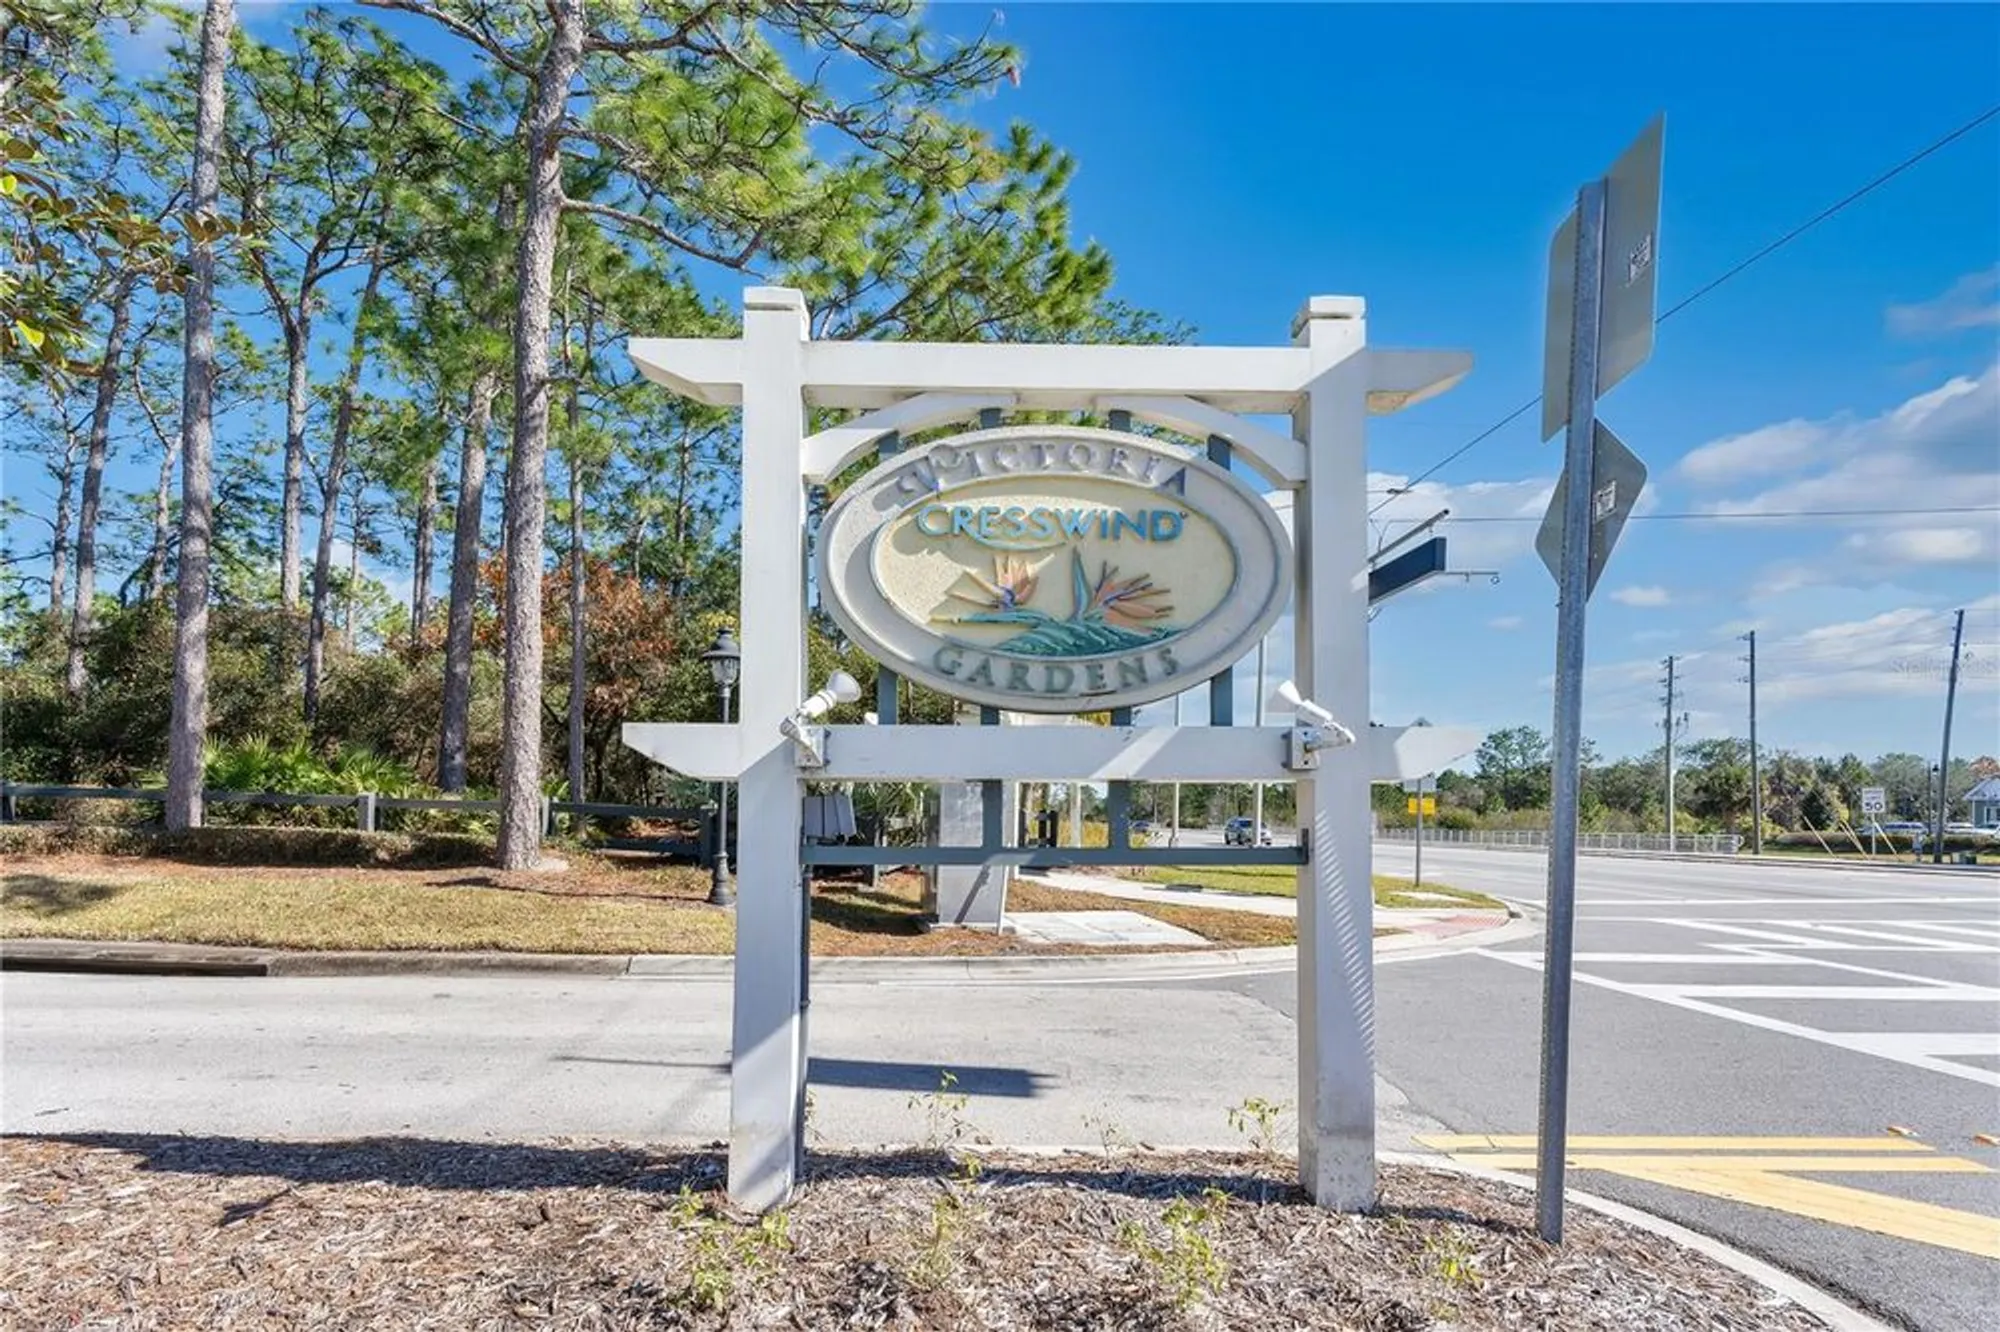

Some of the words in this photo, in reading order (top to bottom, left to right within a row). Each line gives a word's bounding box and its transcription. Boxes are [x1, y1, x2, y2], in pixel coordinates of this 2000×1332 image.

[898, 443, 1187, 498] VICTORIA
[933, 646, 1180, 694] GARDENS
[1864, 801, 1883, 812] 50
